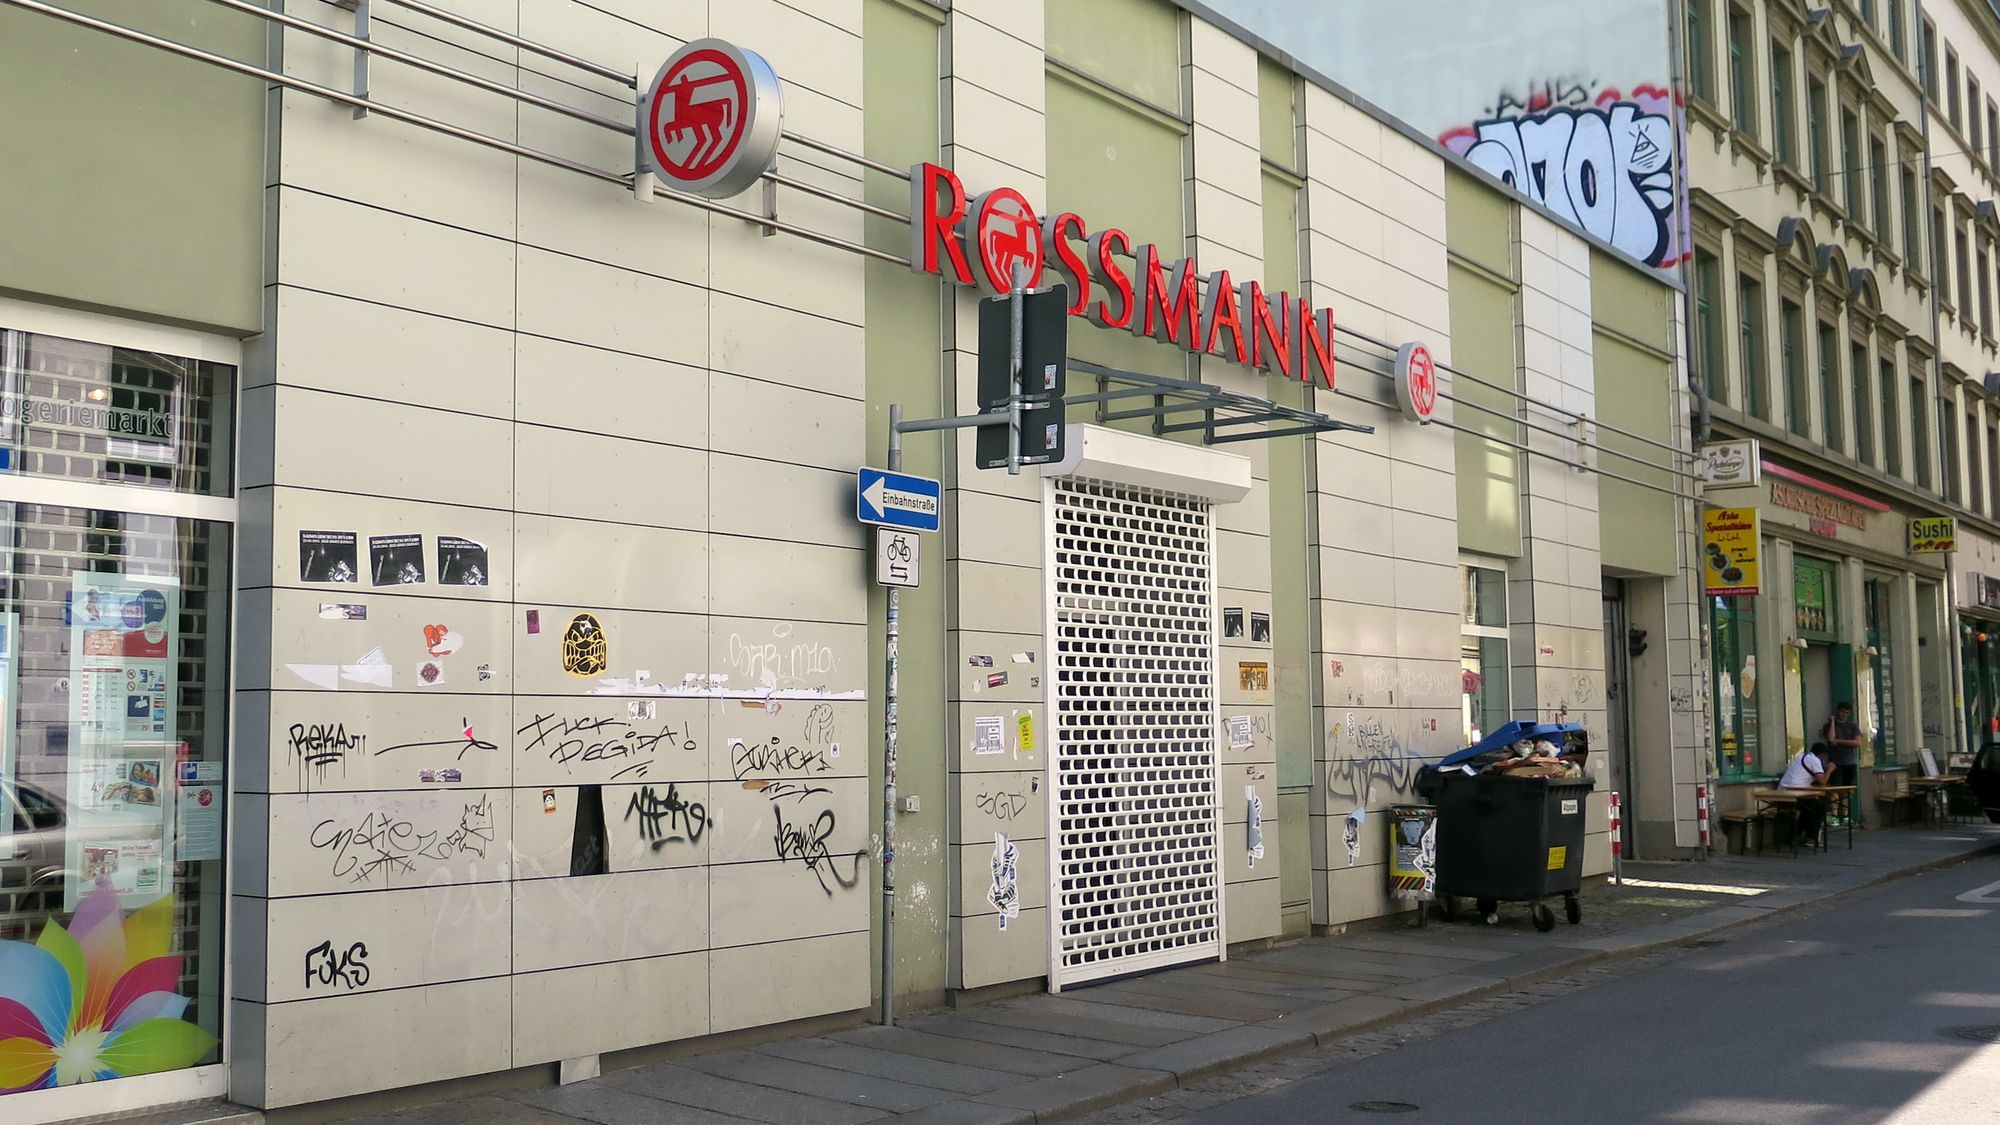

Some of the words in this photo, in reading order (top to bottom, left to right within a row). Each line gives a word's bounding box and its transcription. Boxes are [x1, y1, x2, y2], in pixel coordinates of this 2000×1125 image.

[911, 161, 1335, 390] ROSSMANN
[882, 491, 935, 512] Einbahnstraße
[1718, 510, 1740, 521] Asia
[1912, 520, 1953, 538] Sushi
